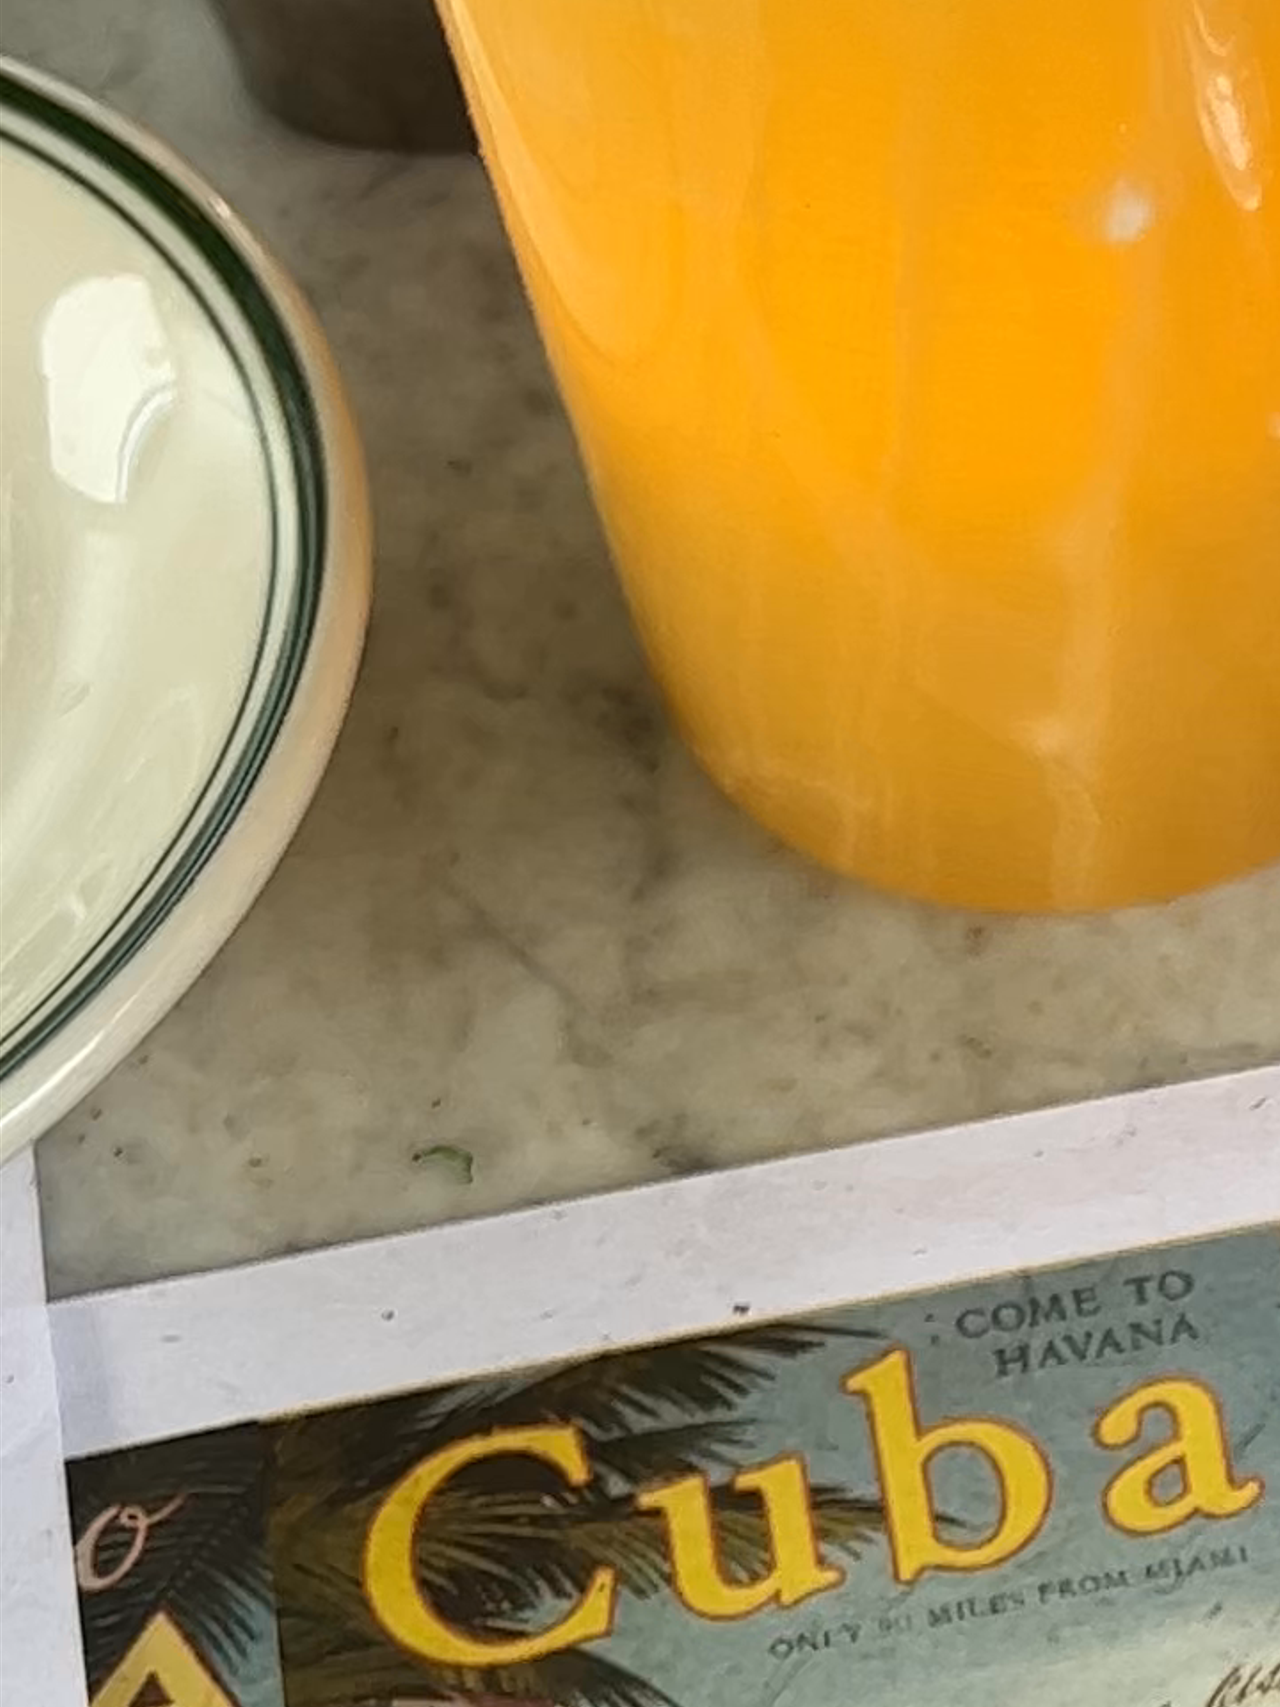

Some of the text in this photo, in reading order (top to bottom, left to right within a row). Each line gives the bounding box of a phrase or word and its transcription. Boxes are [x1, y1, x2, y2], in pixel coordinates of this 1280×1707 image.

[954, 1269, 1196, 1340] COME TO
[991, 1311, 1201, 1379] HAVANA
[361, 1345, 1264, 1670] Cuba
[1036, 1567, 1131, 1606] FROM
